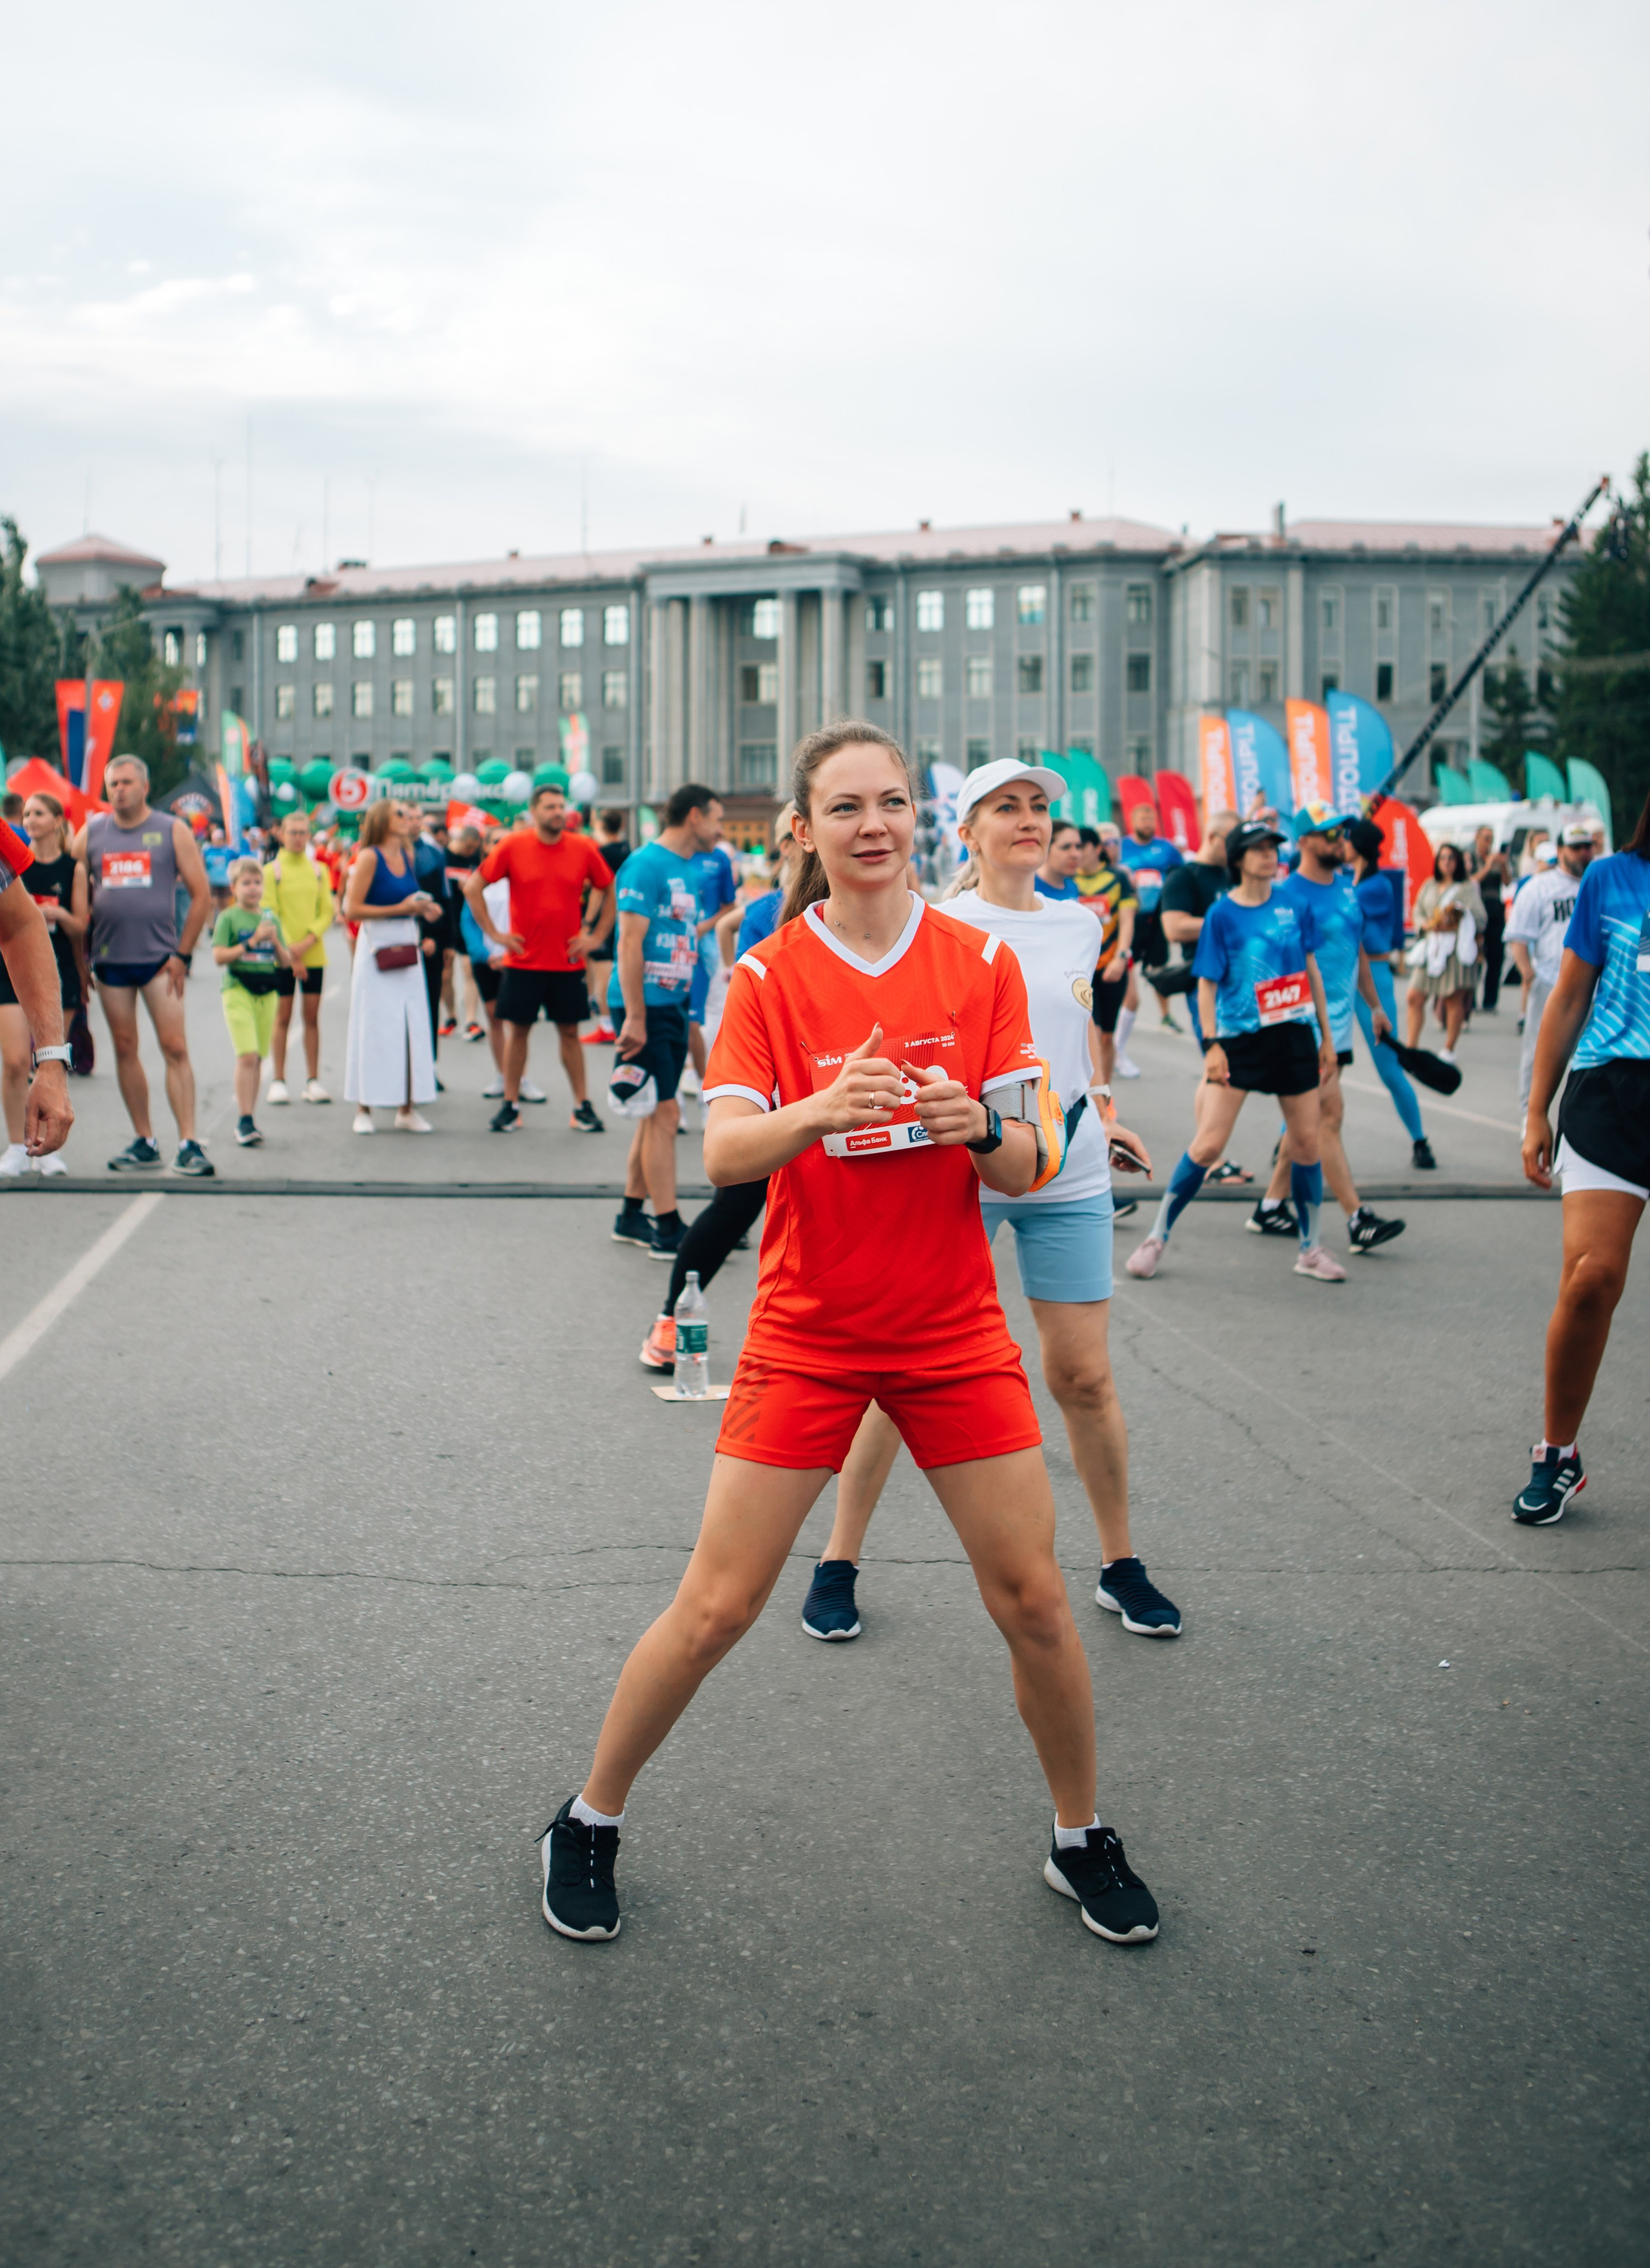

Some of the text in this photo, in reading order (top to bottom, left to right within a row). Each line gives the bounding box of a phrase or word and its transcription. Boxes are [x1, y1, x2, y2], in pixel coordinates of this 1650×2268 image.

[1264, 984, 1301, 1009] 2147
[910, 1037, 940, 1047] АВГУСТА
[849, 1139, 870, 1147] Альфа
